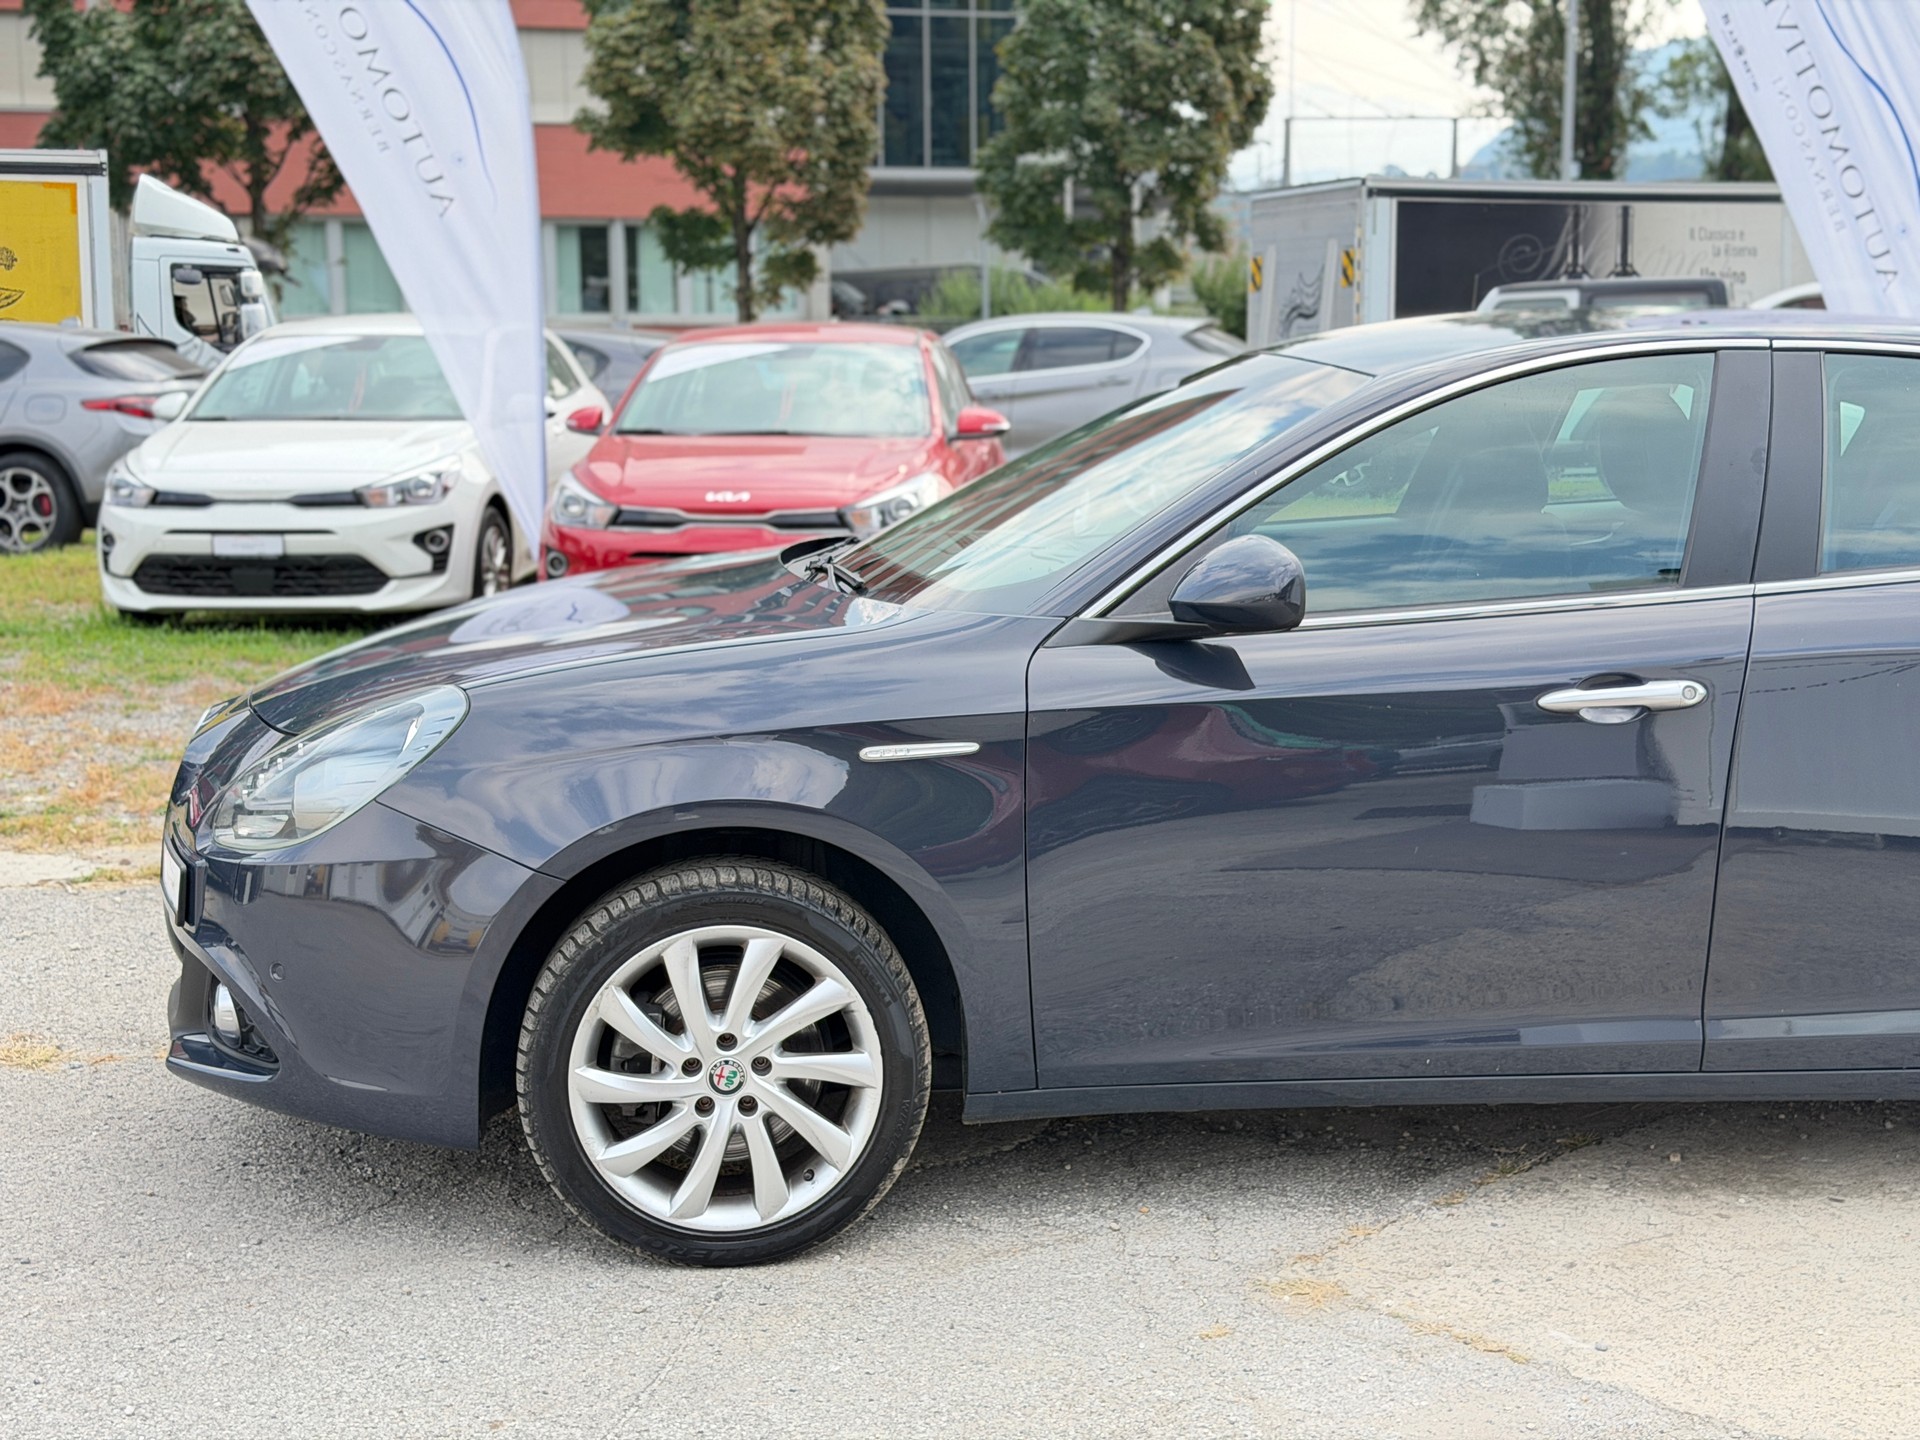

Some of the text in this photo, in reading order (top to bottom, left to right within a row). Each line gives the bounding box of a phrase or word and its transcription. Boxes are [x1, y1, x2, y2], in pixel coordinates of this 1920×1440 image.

[847, 945, 898, 1008] PIRELLI
[711, 1061, 745, 1082] ALFA ROMEO
